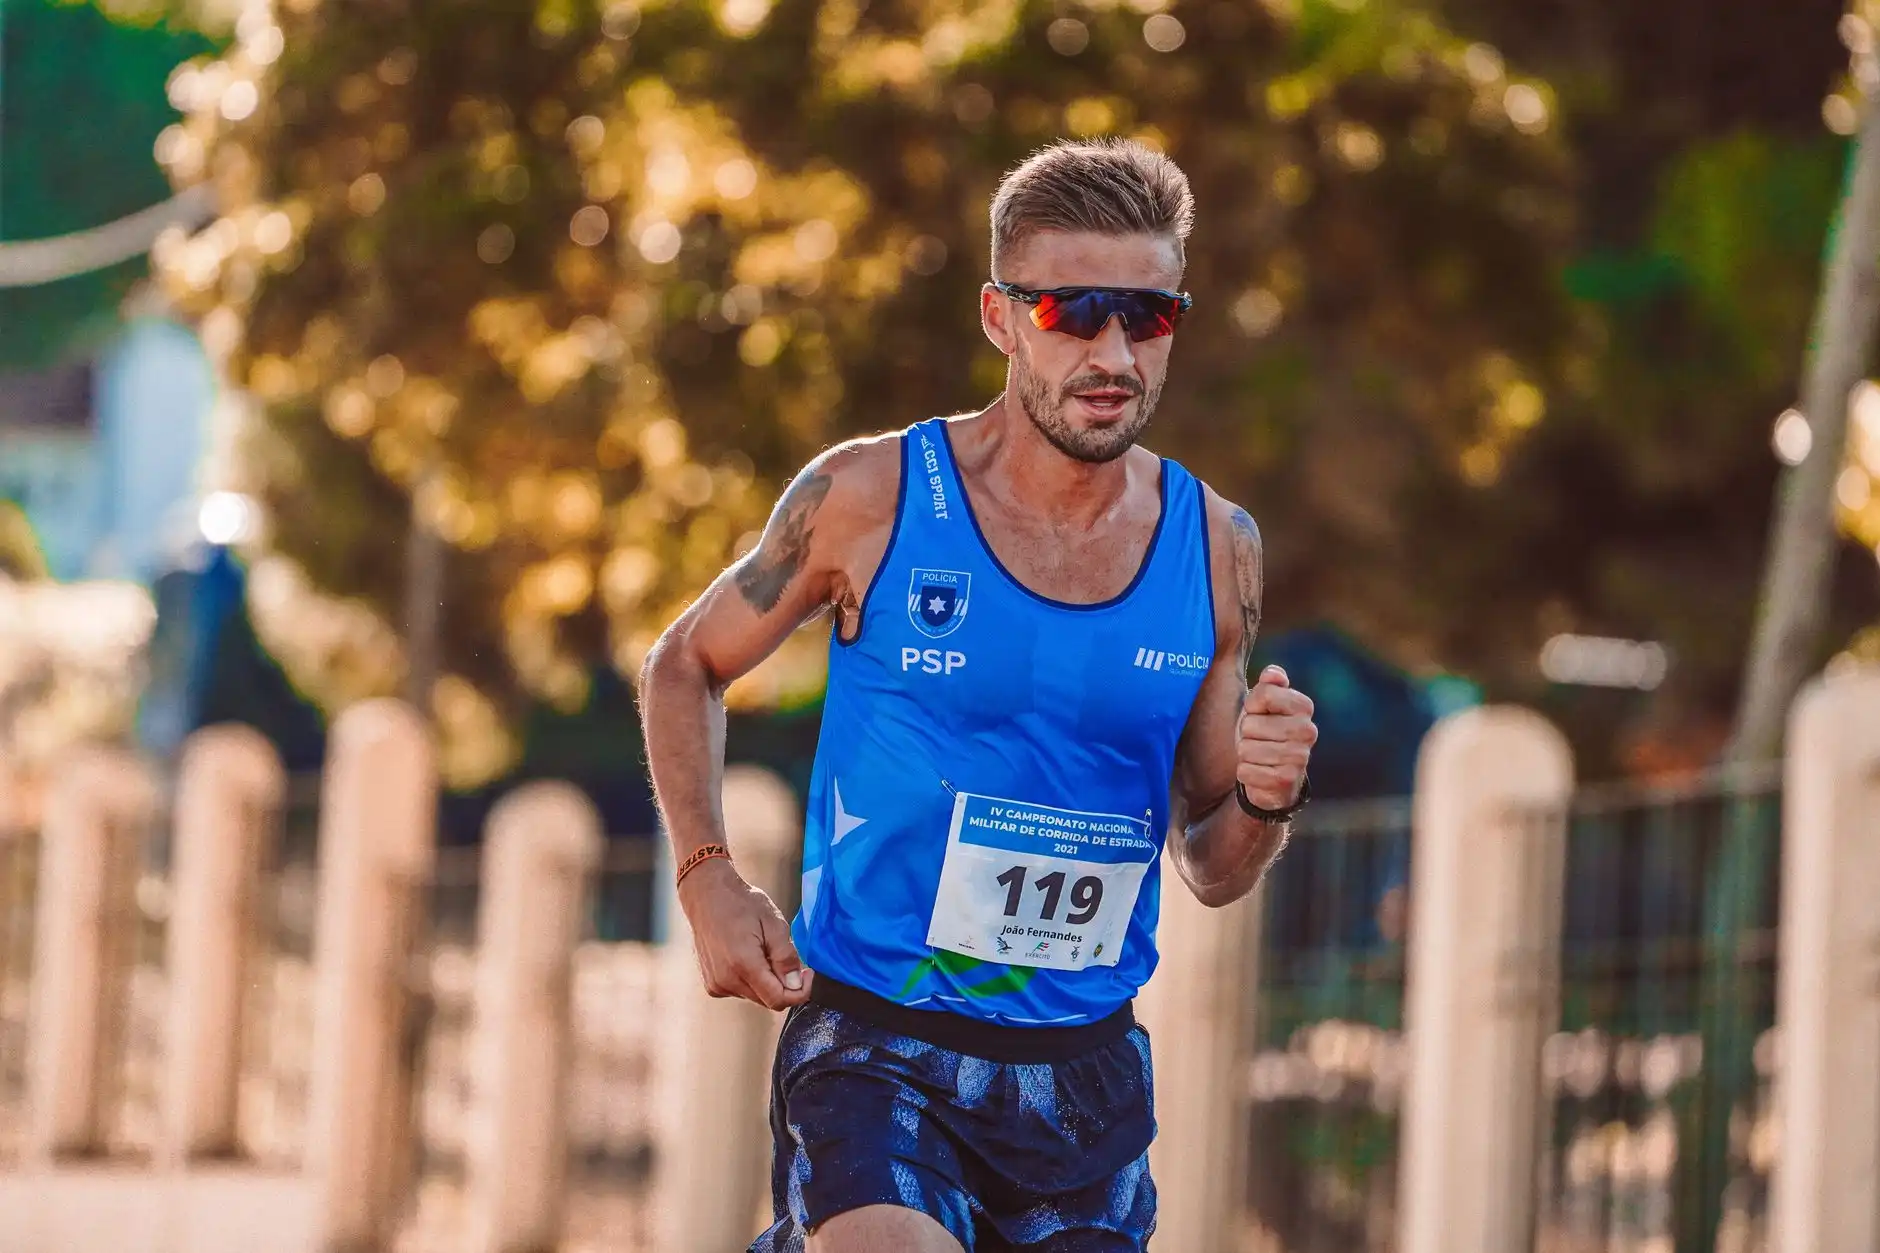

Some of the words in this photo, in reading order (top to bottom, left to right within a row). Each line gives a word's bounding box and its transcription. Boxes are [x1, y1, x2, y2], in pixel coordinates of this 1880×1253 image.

[930, 475, 948, 519] SPORT
[922, 572, 958, 583] POLÍCIA
[901, 647, 967, 675] PSP
[969, 816, 1018, 833] MILITAR
[1019, 825, 1035, 836] DE
[1037, 828, 1089, 843] CORRIDA
[1091, 835, 1107, 846] DE
[1109, 837, 1152, 849] ESTRADA
[990, 806, 1005, 817] IV
[1006, 809, 1087, 830] CAMPEONATO
[1089, 822, 1136, 836] NACIONA
[679, 845, 724, 876] FASTER
[1053, 843, 1078, 855] 2021
[996, 865, 1104, 925] 119
[1000, 924, 1025, 936] João
[1026, 927, 1083, 943] Fernandes
